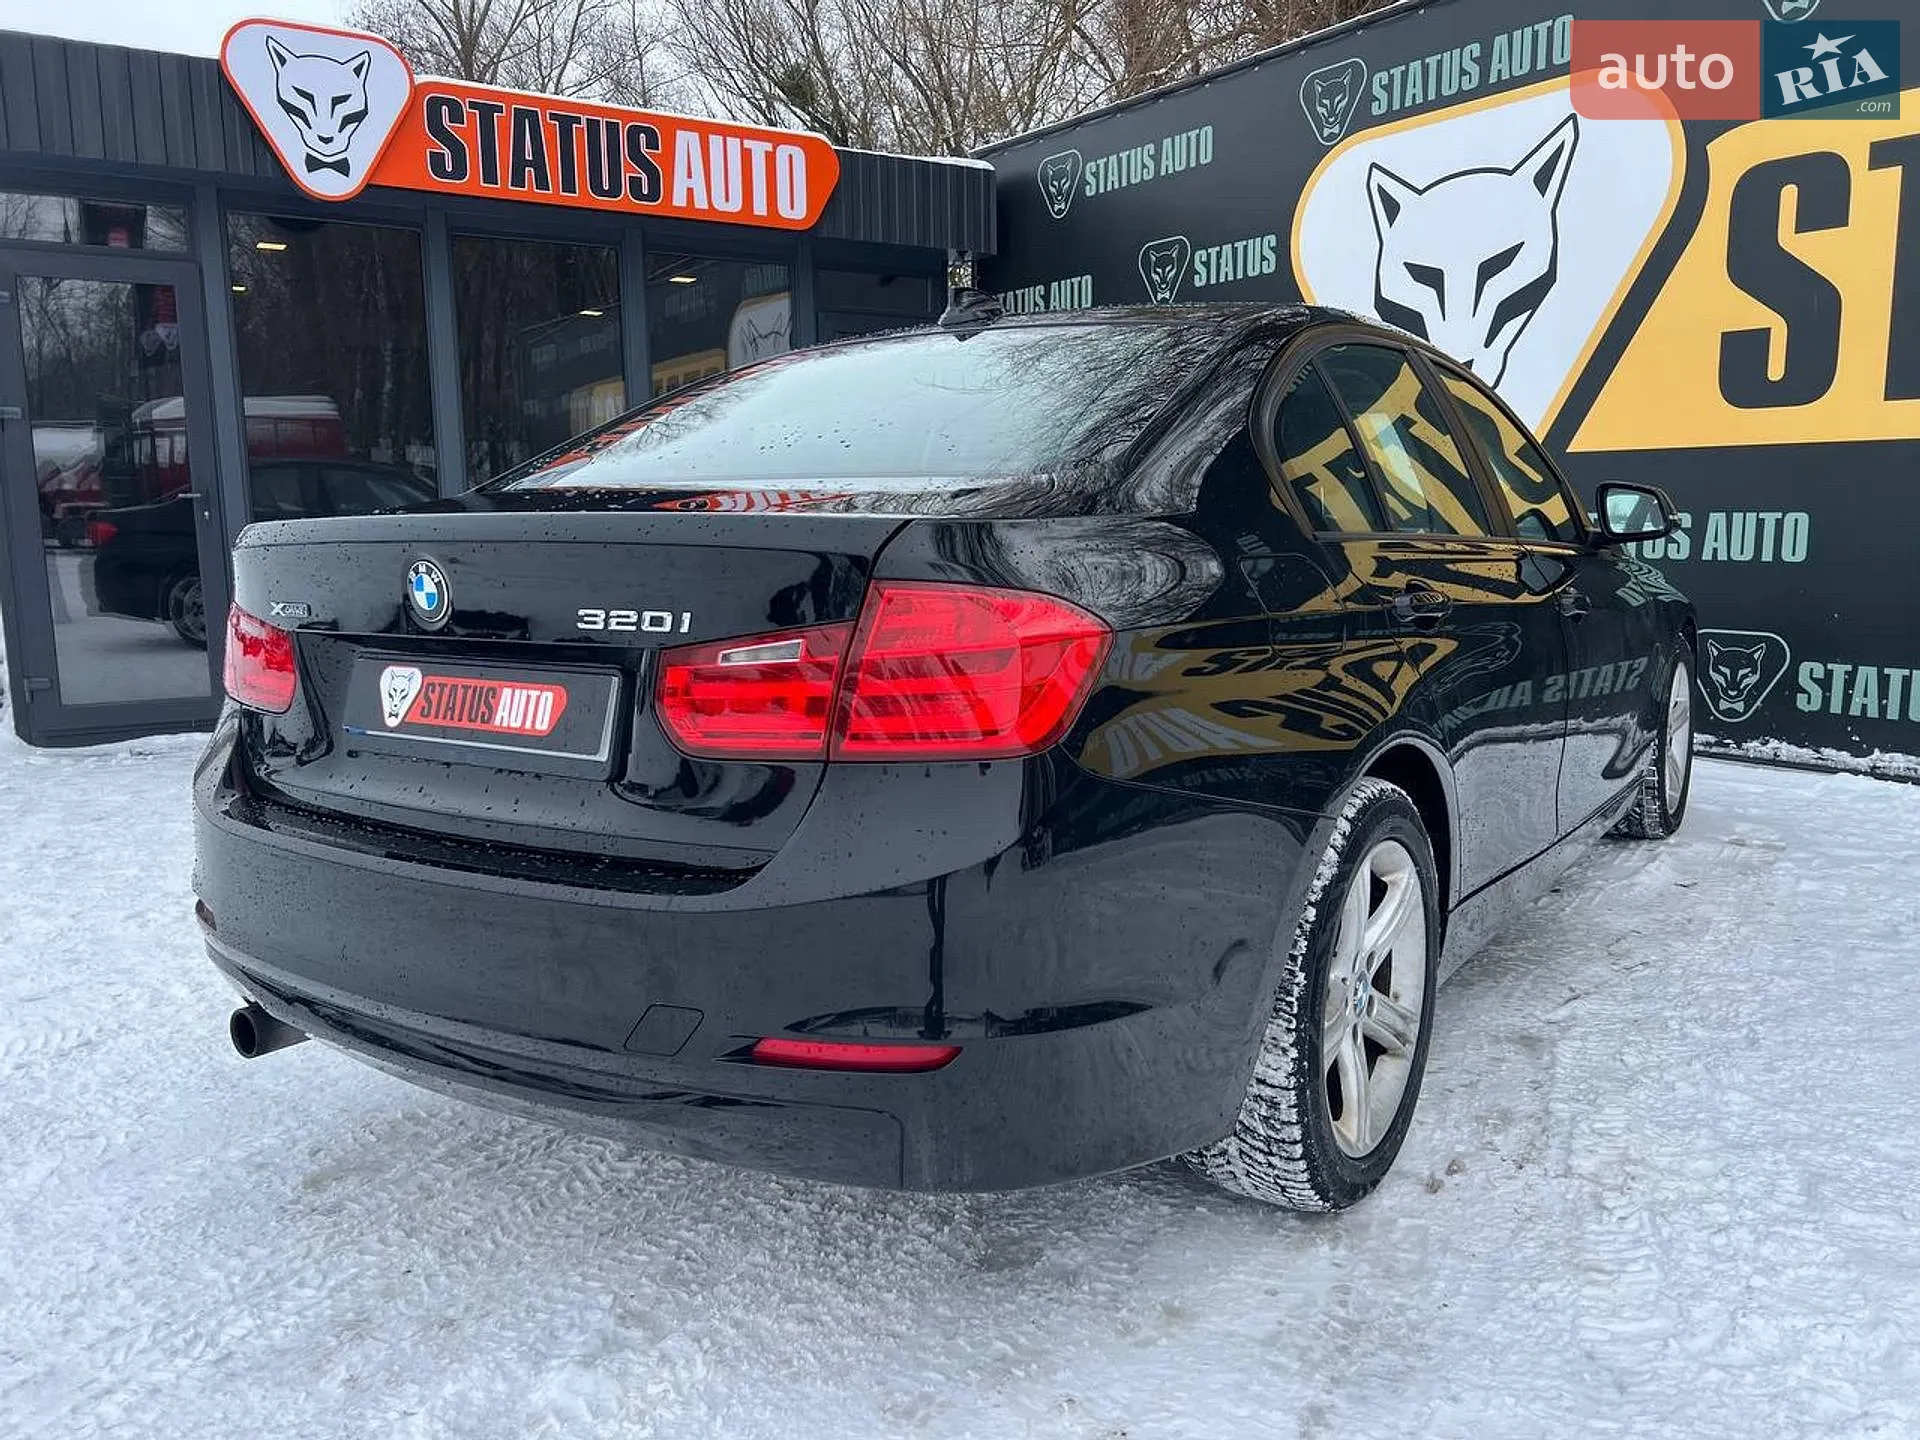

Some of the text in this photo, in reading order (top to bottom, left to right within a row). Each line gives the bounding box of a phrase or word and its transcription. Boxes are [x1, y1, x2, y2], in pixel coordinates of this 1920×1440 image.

[1371, 15, 1575, 116] STATUS AUTO
[423, 94, 807, 221] STATUS AUTO
[1084, 125, 1214, 197] STATUS AUTO
[1193, 234, 1277, 288] STATUS
[1050, 274, 1092, 310] AUTO
[1701, 511, 1809, 563] AUTO
[420, 681, 554, 731] STATUS AUTO
